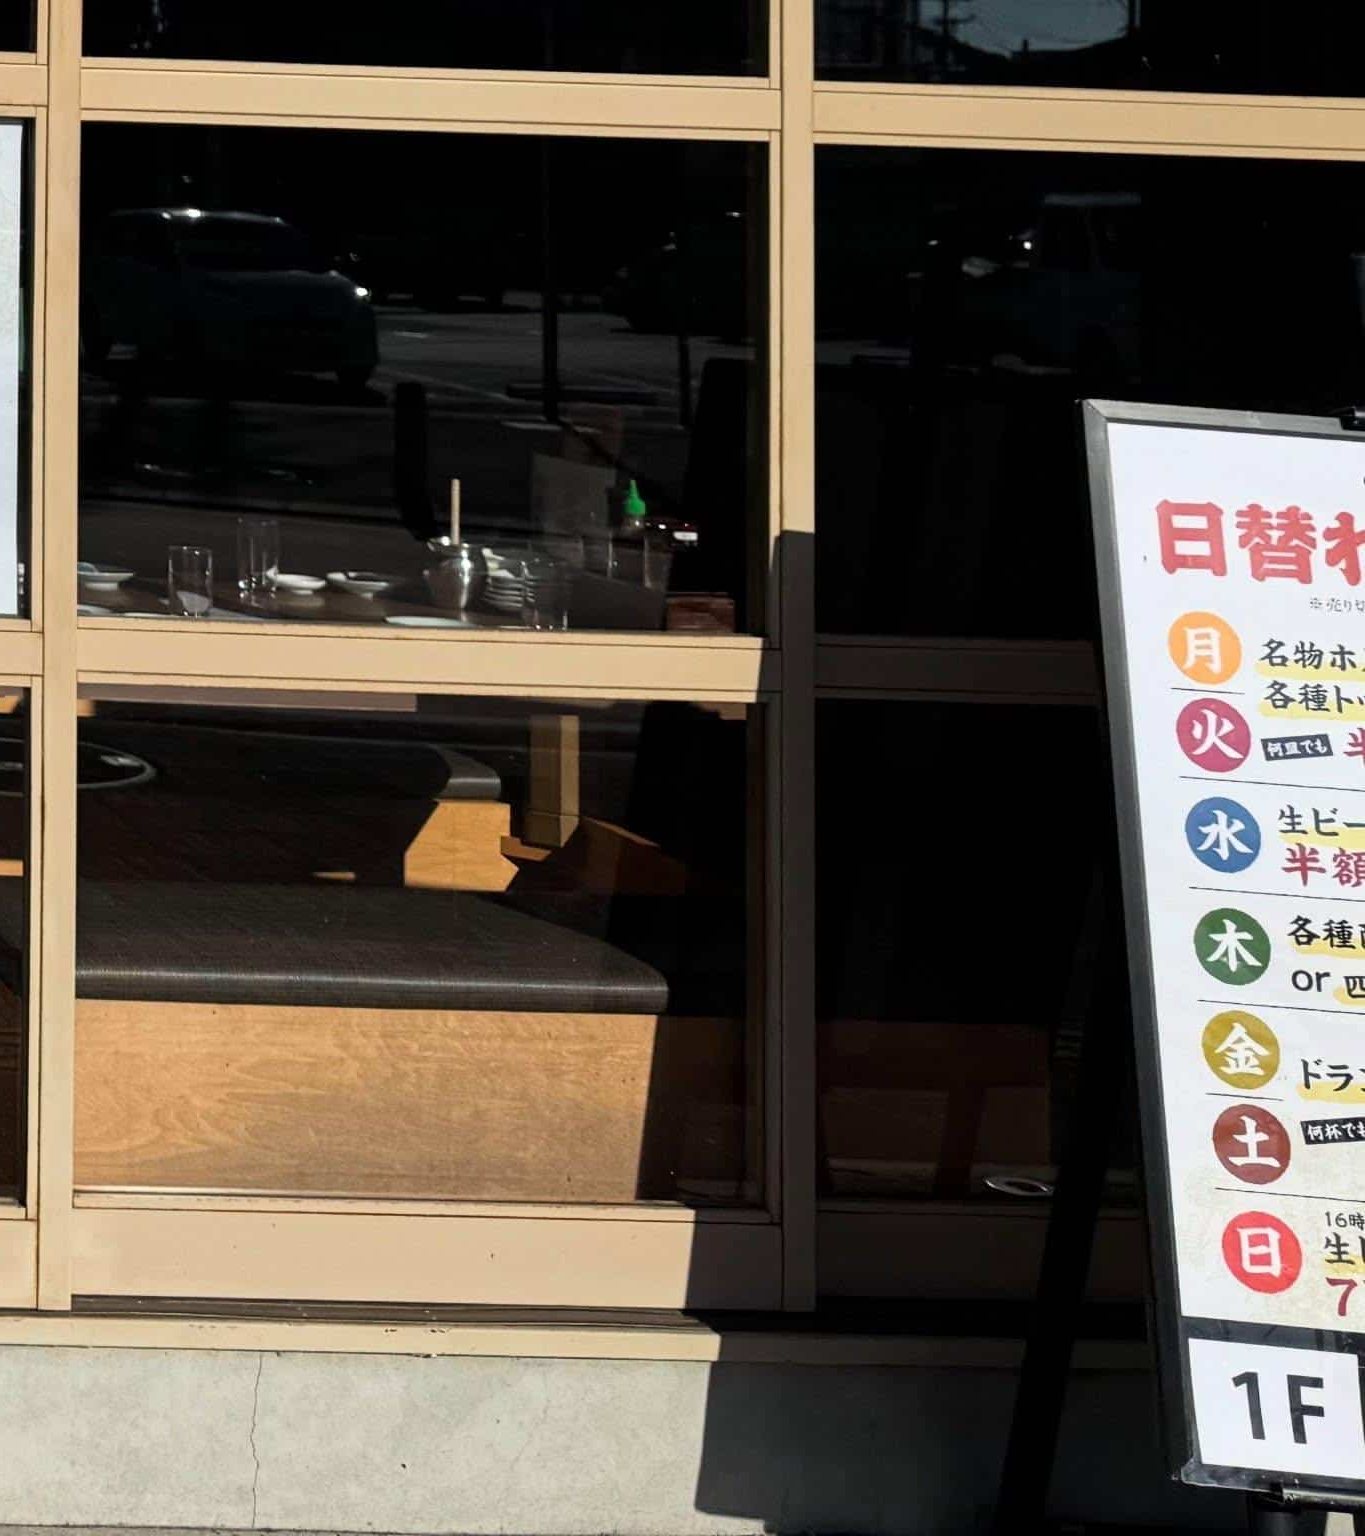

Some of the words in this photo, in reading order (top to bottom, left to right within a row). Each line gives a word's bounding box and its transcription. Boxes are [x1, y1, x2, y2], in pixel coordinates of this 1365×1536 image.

[1184, 628, 1222, 674] 月
[1259, 638, 1365, 672] 名物ホ
[1191, 710, 1242, 758] 火
[1198, 810, 1252, 860] 水
[1208, 920, 1261, 972] 木
[1287, 915, 1365, 950] 各種
[1291, 969, 1331, 993] or
[1215, 1025, 1269, 1075] 金
[1300, 1058, 1365, 1093] ドラ
[1227, 1116, 1279, 1167] 土
[1237, 1229, 1280, 1278] 日
[1232, 1371, 1325, 1444] 1F
